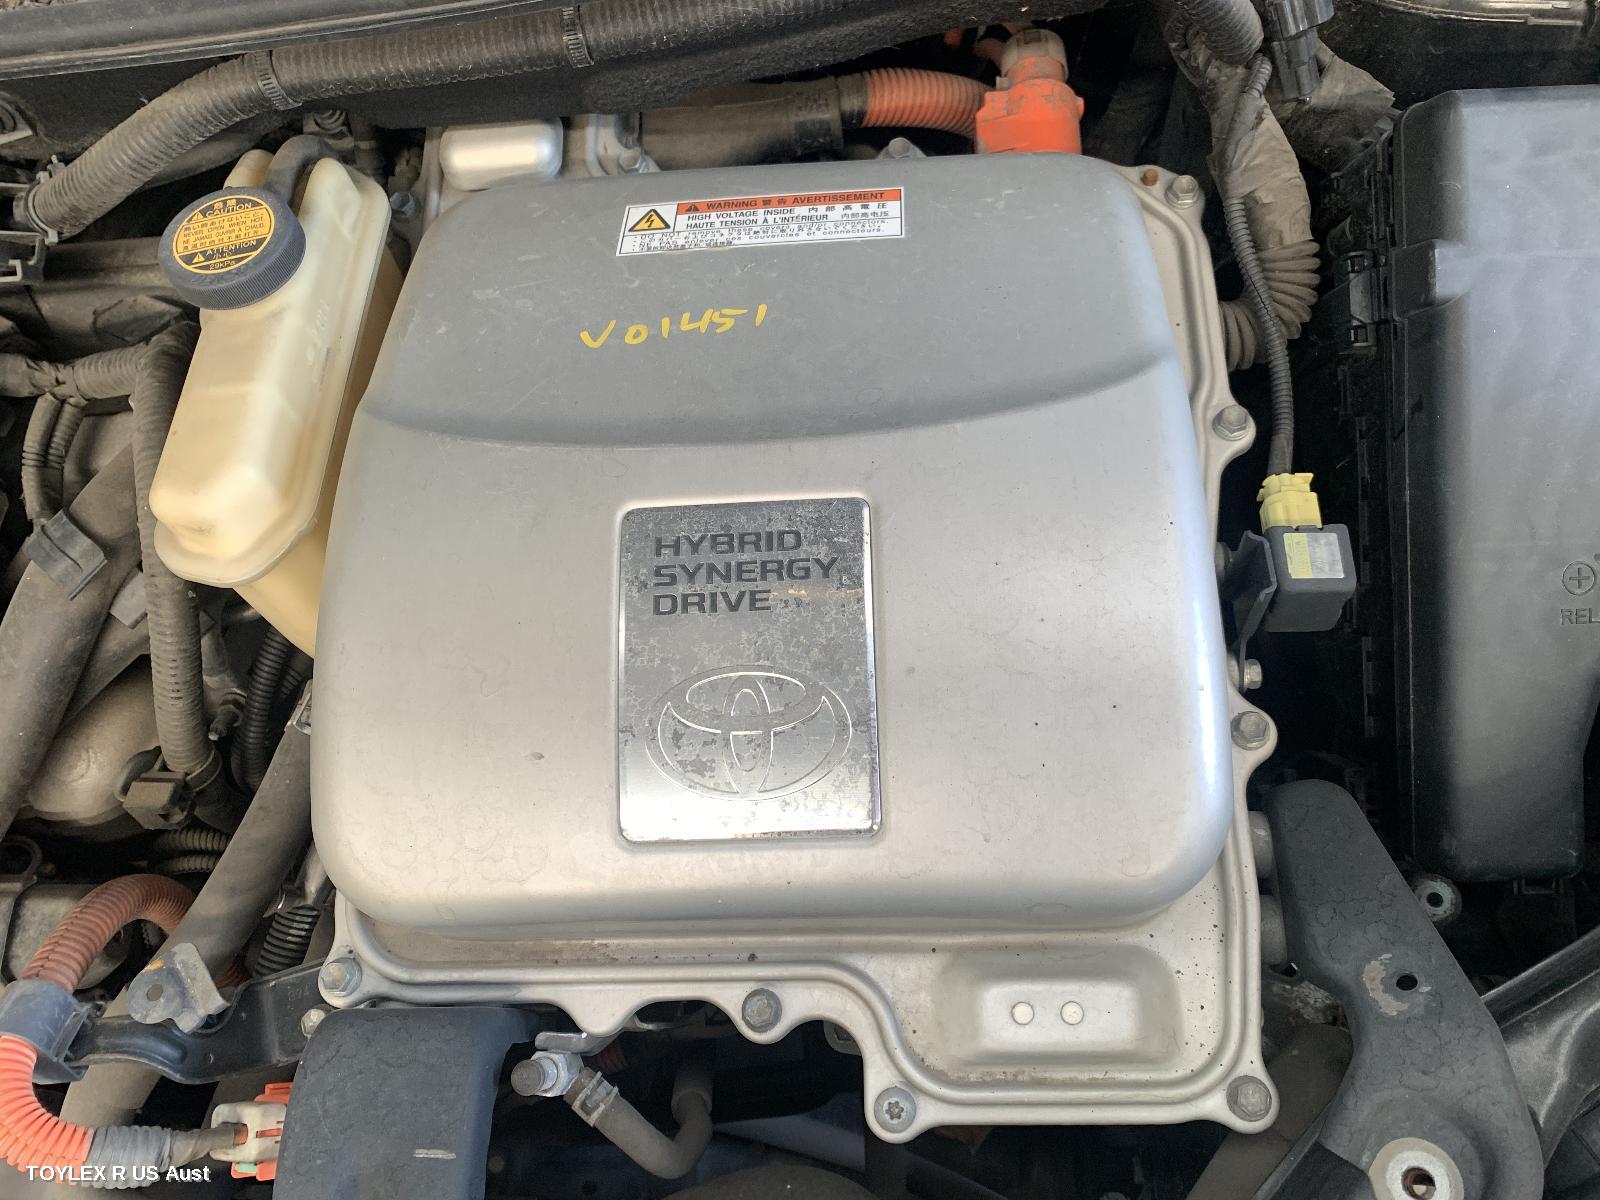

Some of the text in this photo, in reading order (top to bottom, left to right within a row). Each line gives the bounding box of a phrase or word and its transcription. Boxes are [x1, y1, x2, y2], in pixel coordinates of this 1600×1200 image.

[206, 202, 252, 217] CAUTION
[706, 200, 758, 210] WARNING
[792, 192, 884, 204] AVERTISSEMENT
[686, 221, 716, 230] HAUTE
[720, 218, 758, 228] TENSION
[773, 214, 828, 224] L'INTÉRIEUR
[687, 213, 711, 222] HIGH
[716, 210, 759, 220] VOLTAGE
[763, 208, 796, 216] INSIDE
[183, 216, 264, 238] NEVER OPEN WHEN HOT
[206, 239, 257, 256] ATTENTION
[209, 260, 236, 271] 29kPa
[653, 529, 802, 558] HYBRID
[652, 556, 839, 587] SYNERGY
[651, 588, 772, 616] DRIVE
